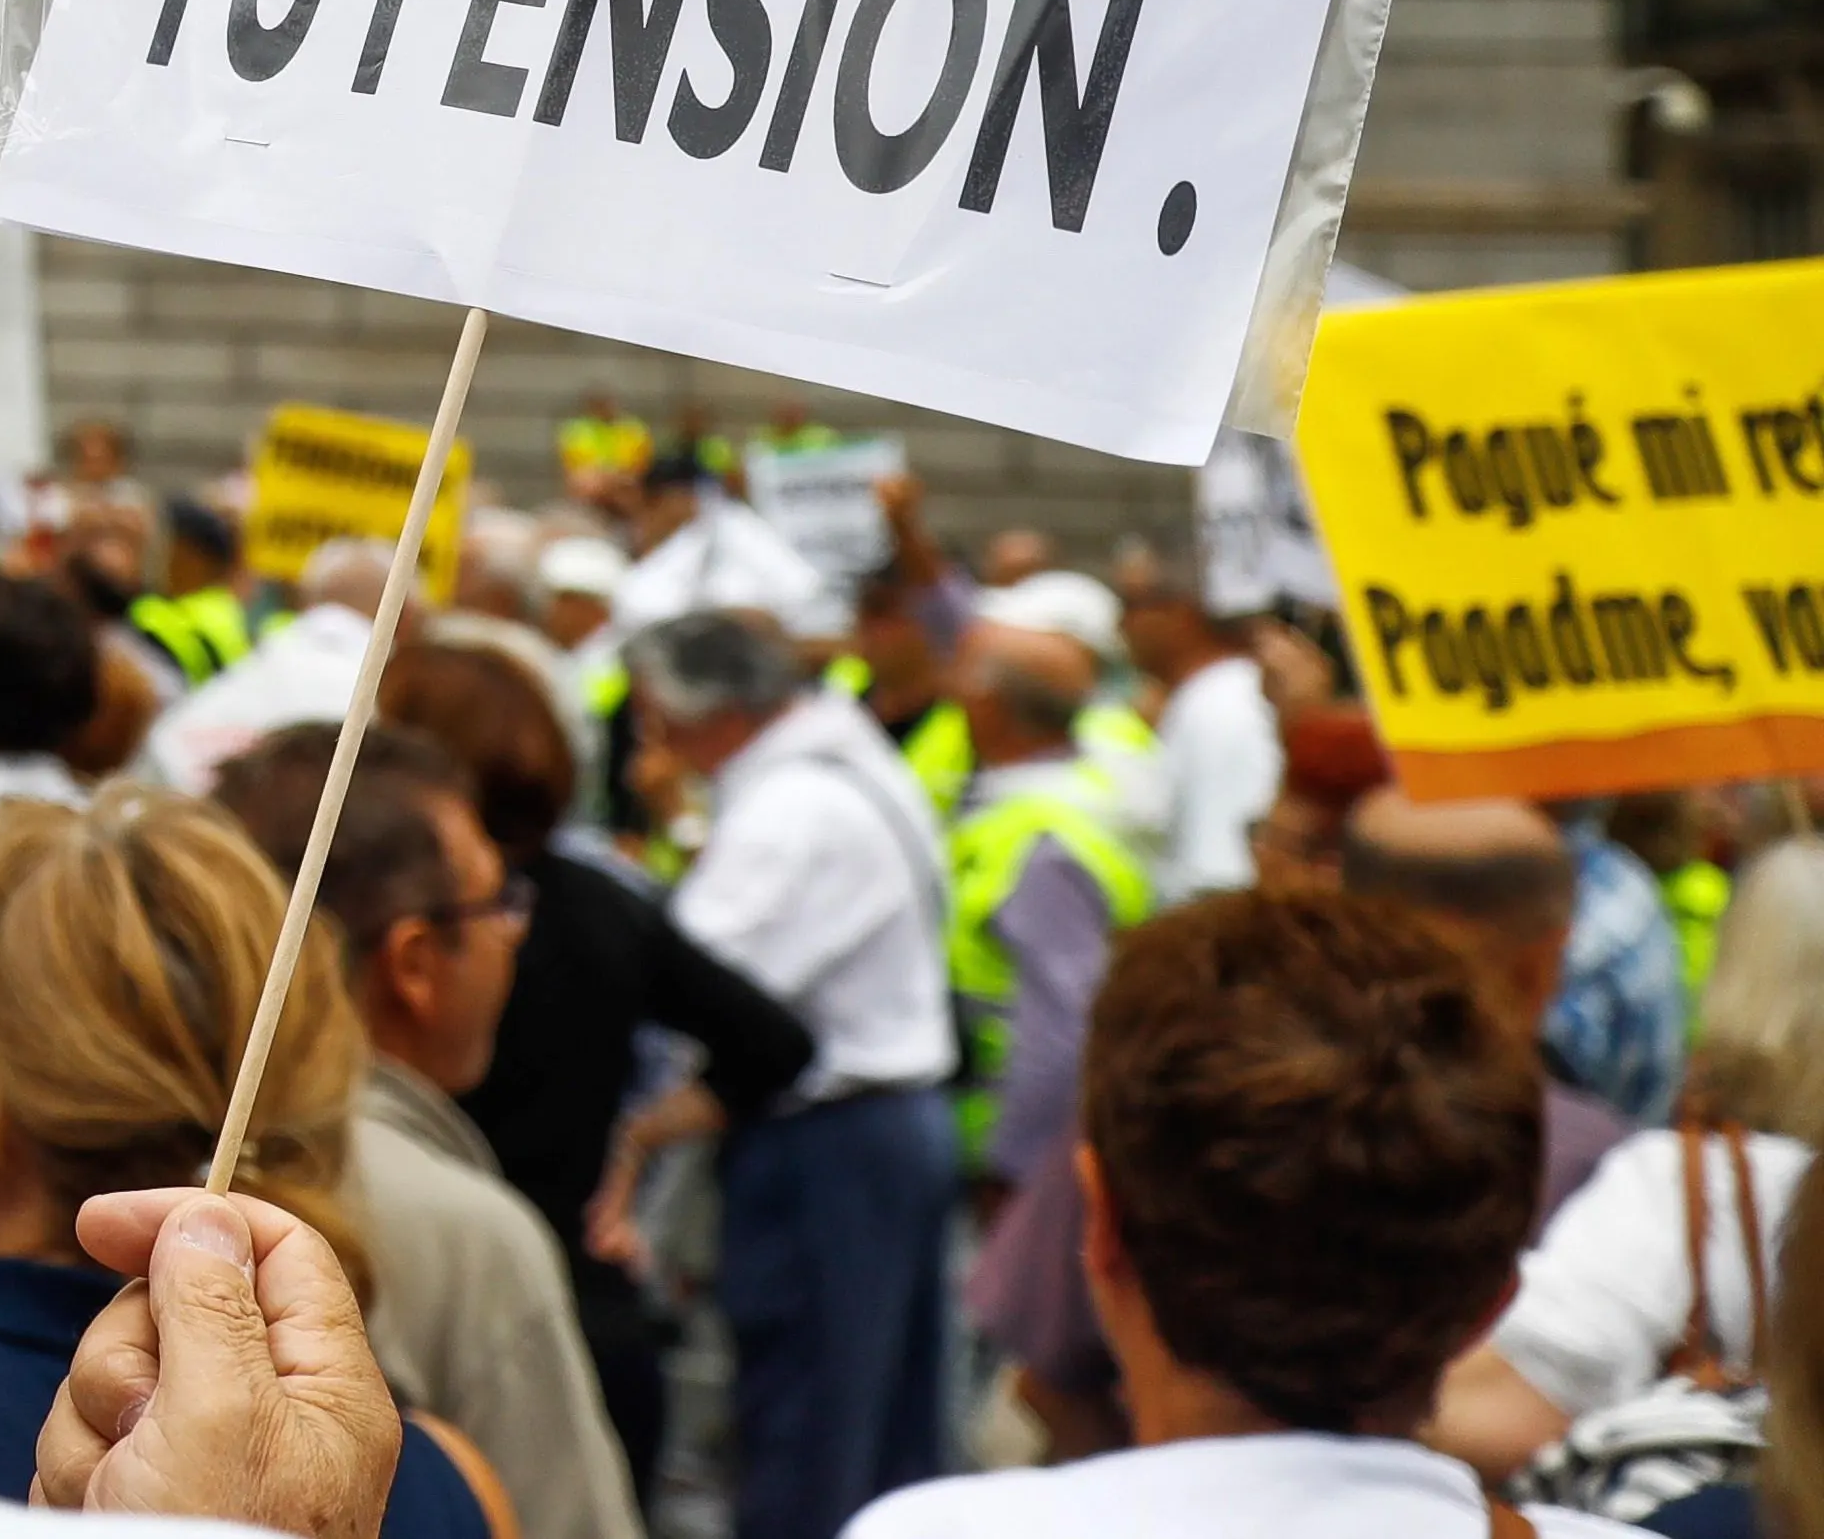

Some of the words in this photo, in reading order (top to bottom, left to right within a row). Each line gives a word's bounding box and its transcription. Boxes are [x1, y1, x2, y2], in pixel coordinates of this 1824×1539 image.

[1382, 387, 1623, 532] Pagué
[1628, 382, 1734, 506] mi
[1362, 568, 1737, 714] Pagadme,
